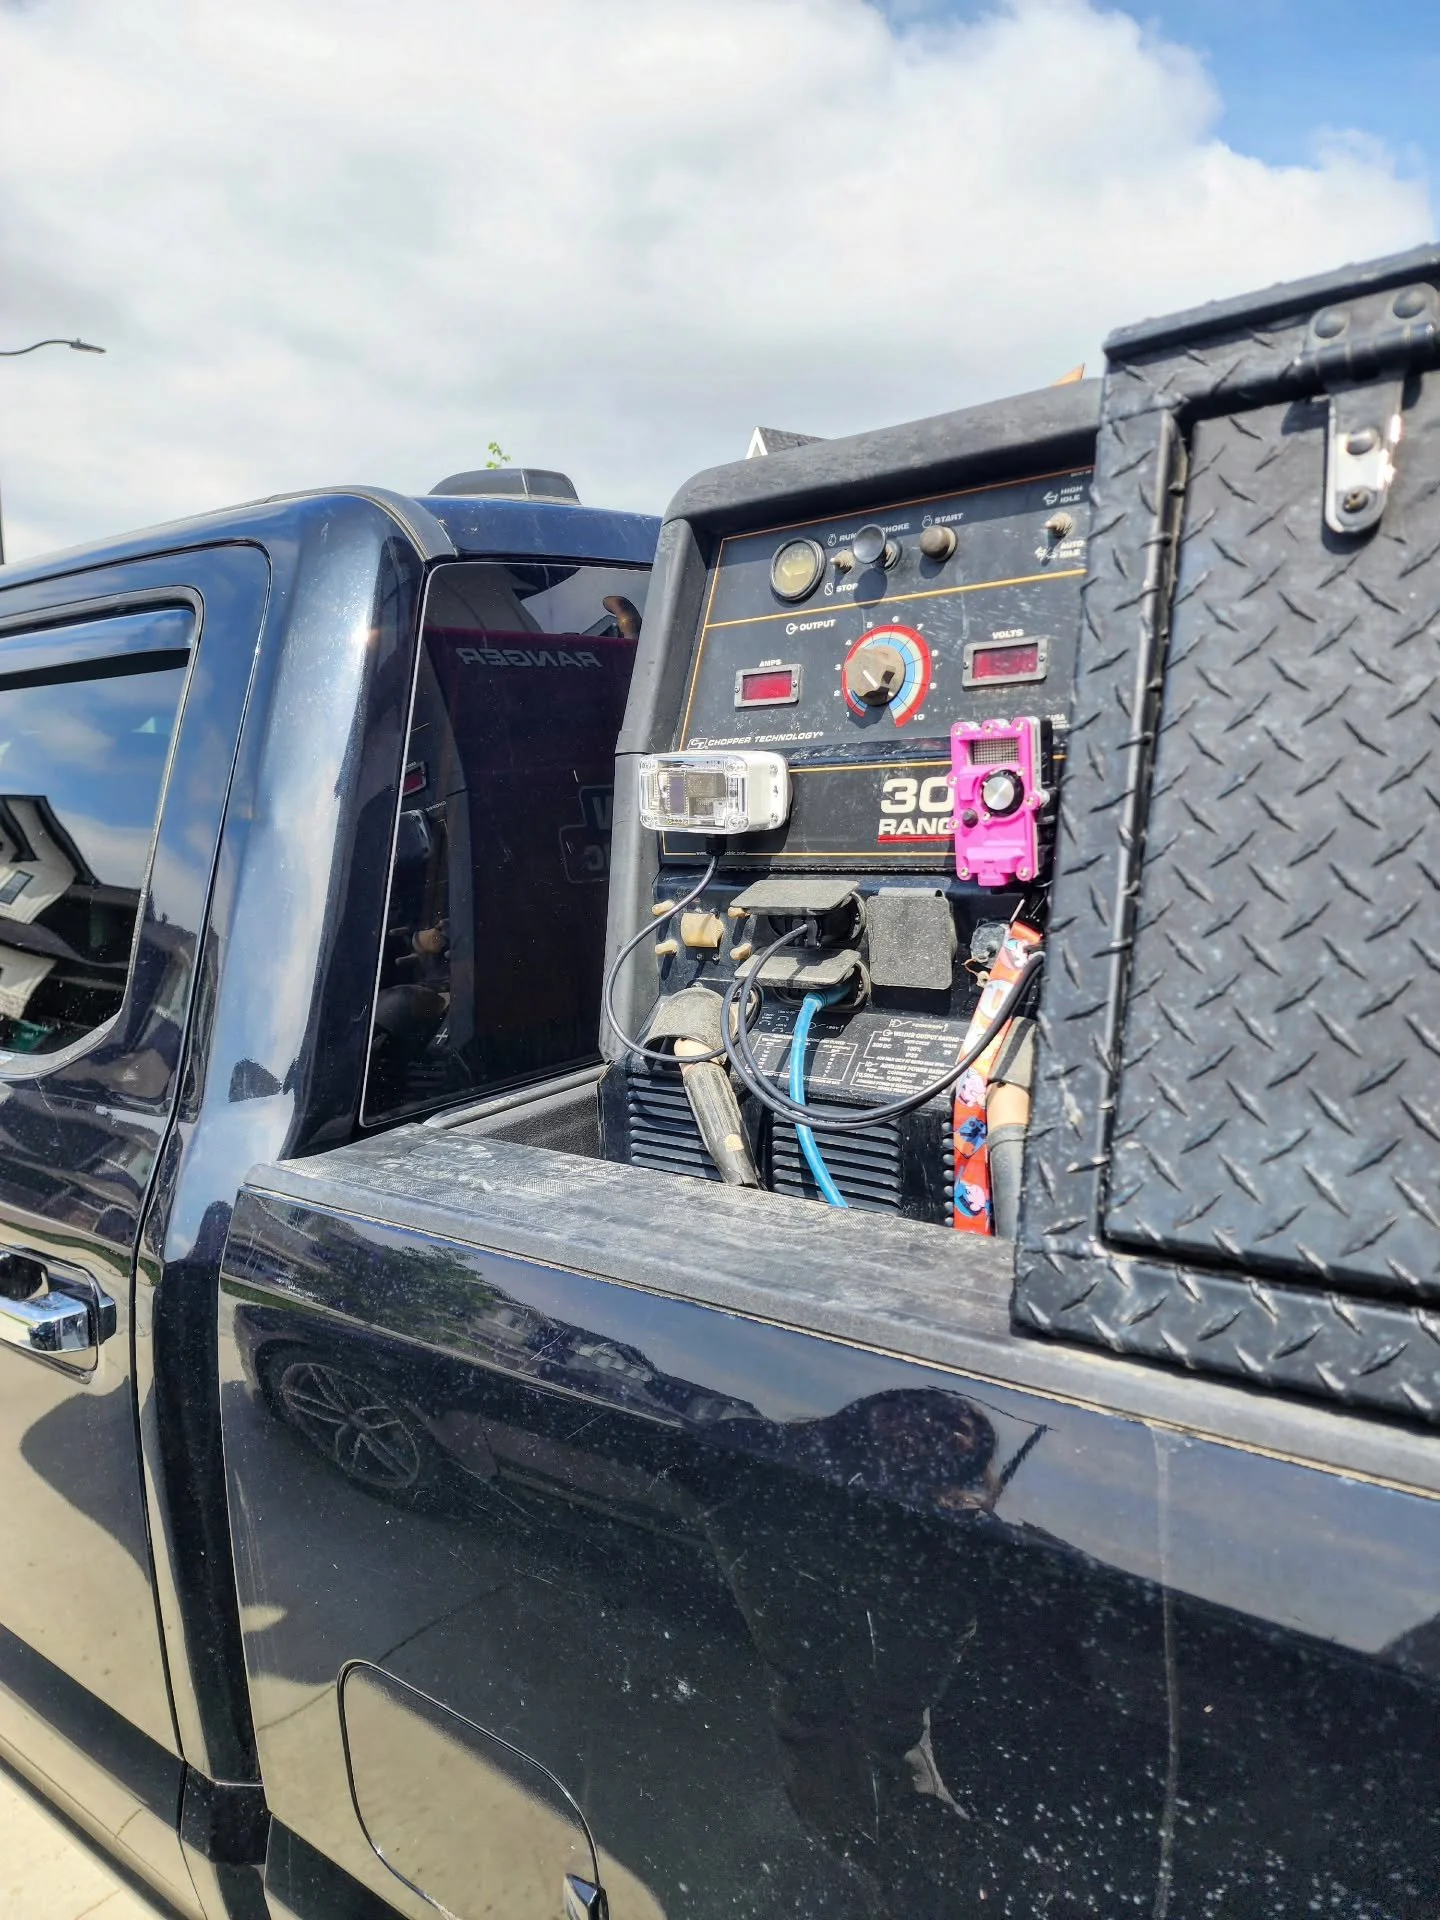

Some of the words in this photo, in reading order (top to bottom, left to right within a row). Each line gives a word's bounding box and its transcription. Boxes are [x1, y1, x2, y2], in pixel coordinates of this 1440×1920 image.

[1060, 485, 1083, 494] HIGH
[1060, 494, 1081, 504] IDLE
[934, 512, 964, 524] START
[1060, 540, 1085, 550] AUTO
[836, 582, 858, 593] STOP
[800, 618, 836, 632] OUTPUT
[992, 628, 1024, 640] VOLTS
[759, 658, 782, 668] AMPS
[930, 682, 937, 690] 9
[708, 736, 752, 746] CHOPPER
